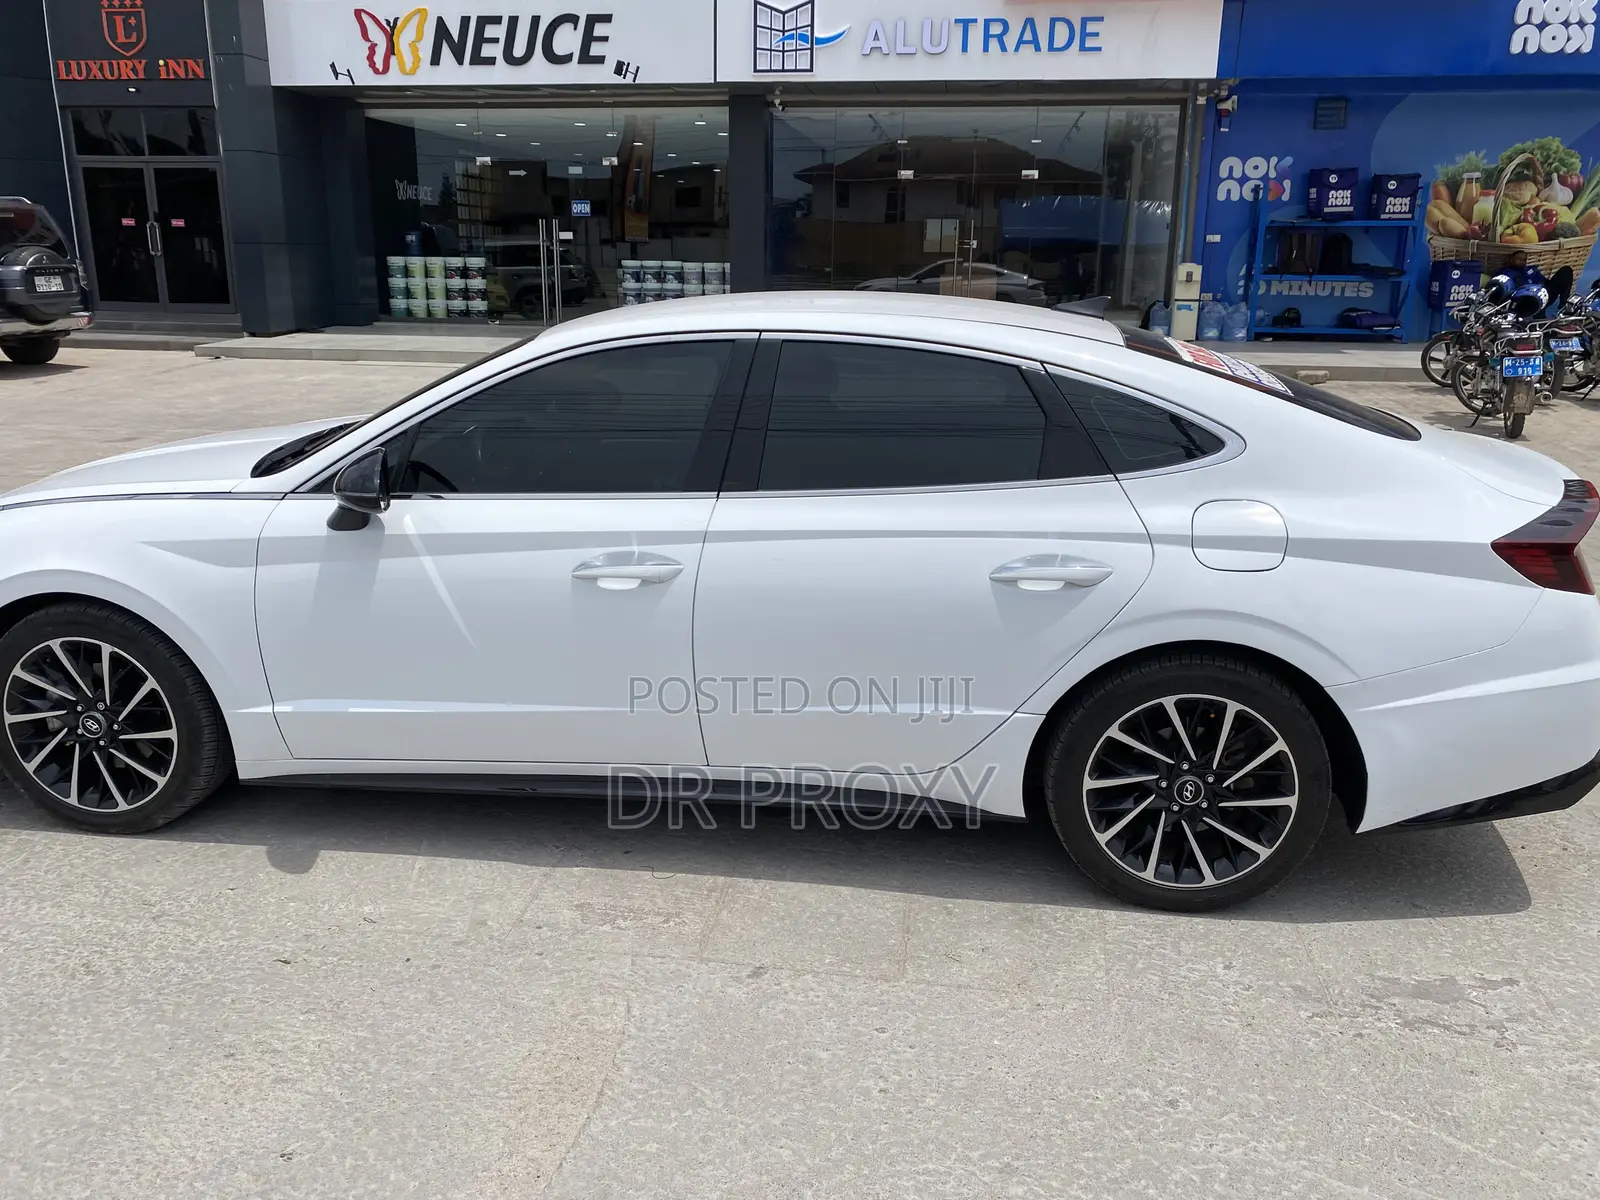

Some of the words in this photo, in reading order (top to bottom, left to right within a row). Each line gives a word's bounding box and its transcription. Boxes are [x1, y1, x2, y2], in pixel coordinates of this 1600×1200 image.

[113, 15, 137, 43] L
[430, 13, 613, 67] NEUCE
[861, 16, 1105, 55] ALUTRADE
[56, 58, 148, 80] LUXURY
[572, 203, 590, 214] OPEN
[1270, 280, 1374, 297] MINUTES
